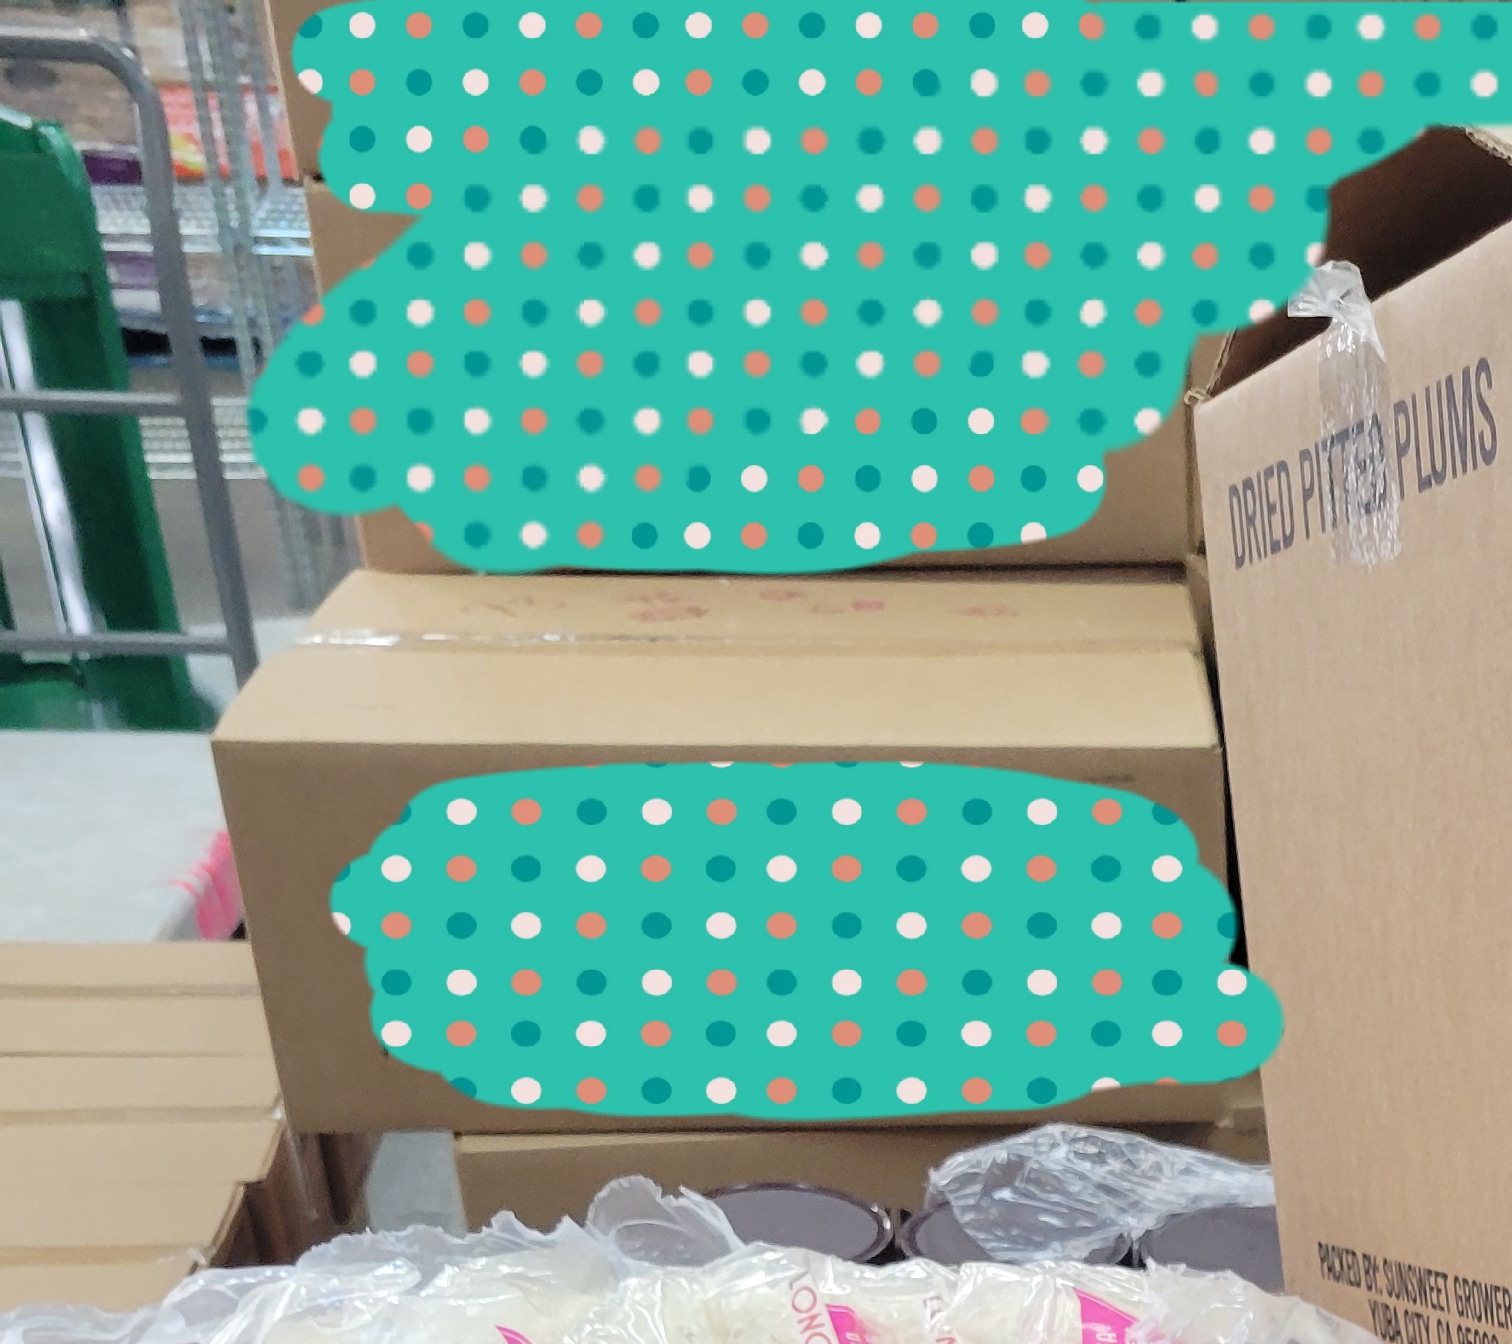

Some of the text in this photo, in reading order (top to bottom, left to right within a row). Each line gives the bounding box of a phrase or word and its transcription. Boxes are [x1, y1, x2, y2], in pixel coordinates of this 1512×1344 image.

[1229, 357, 1498, 570] DRIED PITTED PLUMS
[1317, 1240, 1362, 1289] PACKED
[1382, 1257, 1452, 1315] SUNSWEET
